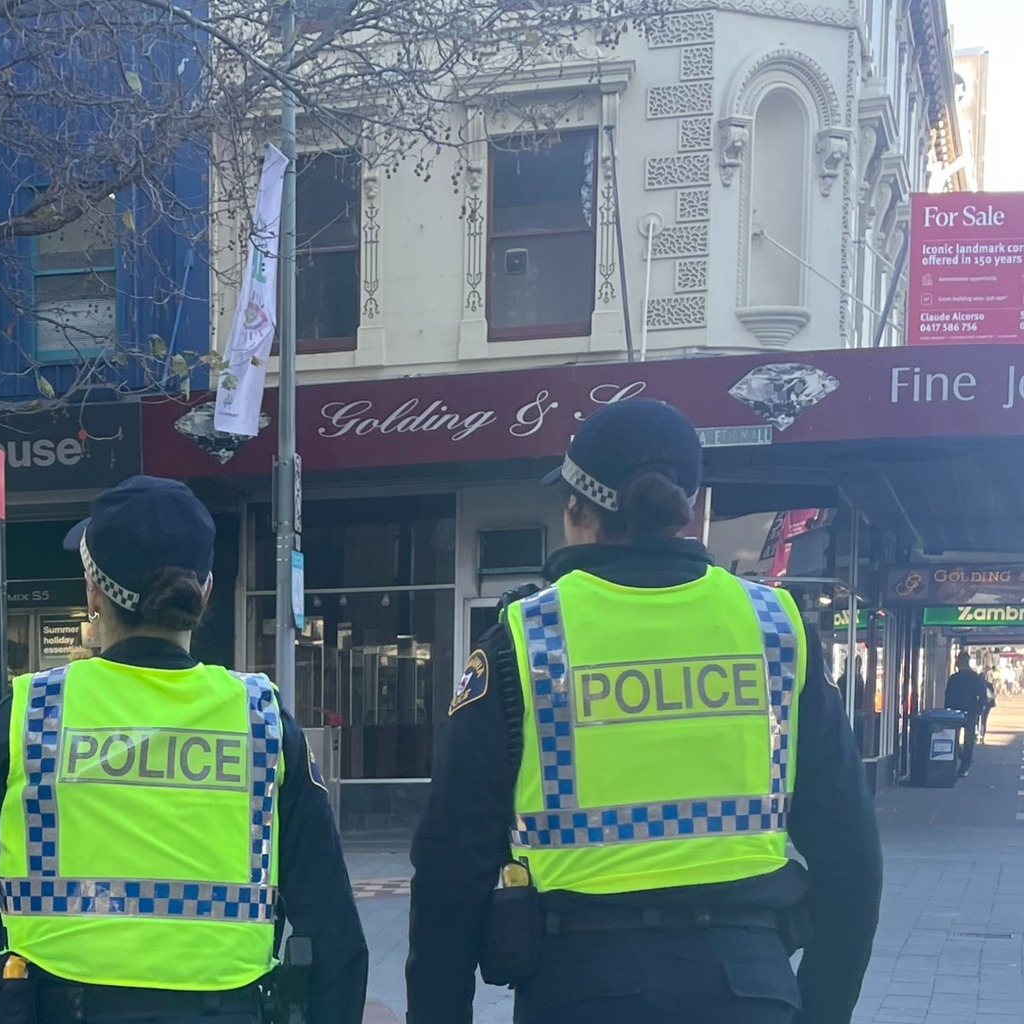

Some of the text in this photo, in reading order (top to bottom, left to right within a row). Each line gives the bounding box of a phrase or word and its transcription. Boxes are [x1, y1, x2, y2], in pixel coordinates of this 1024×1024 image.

[923, 205, 1005, 228] For Sale
[922, 243, 954, 255] Iconic
[956, 242, 1005, 254] landmark
[922, 255, 1023, 267] offered in 150 years
[920, 312, 985, 322] Claude Alcorso
[920, 323, 978, 332] 0417 586 756
[890, 366, 977, 403] Fine
[318, 398, 497, 441] Golding
[509, 390, 559, 437] &
[933, 569, 1013, 582] GOLDING
[7, 593, 29, 601] MIX
[31, 590, 50, 601] S5
[42, 625, 80, 634] Summer
[43, 635, 75, 645] holiday
[580, 663, 760, 718] POLICE
[67, 733, 241, 783] POLICE
